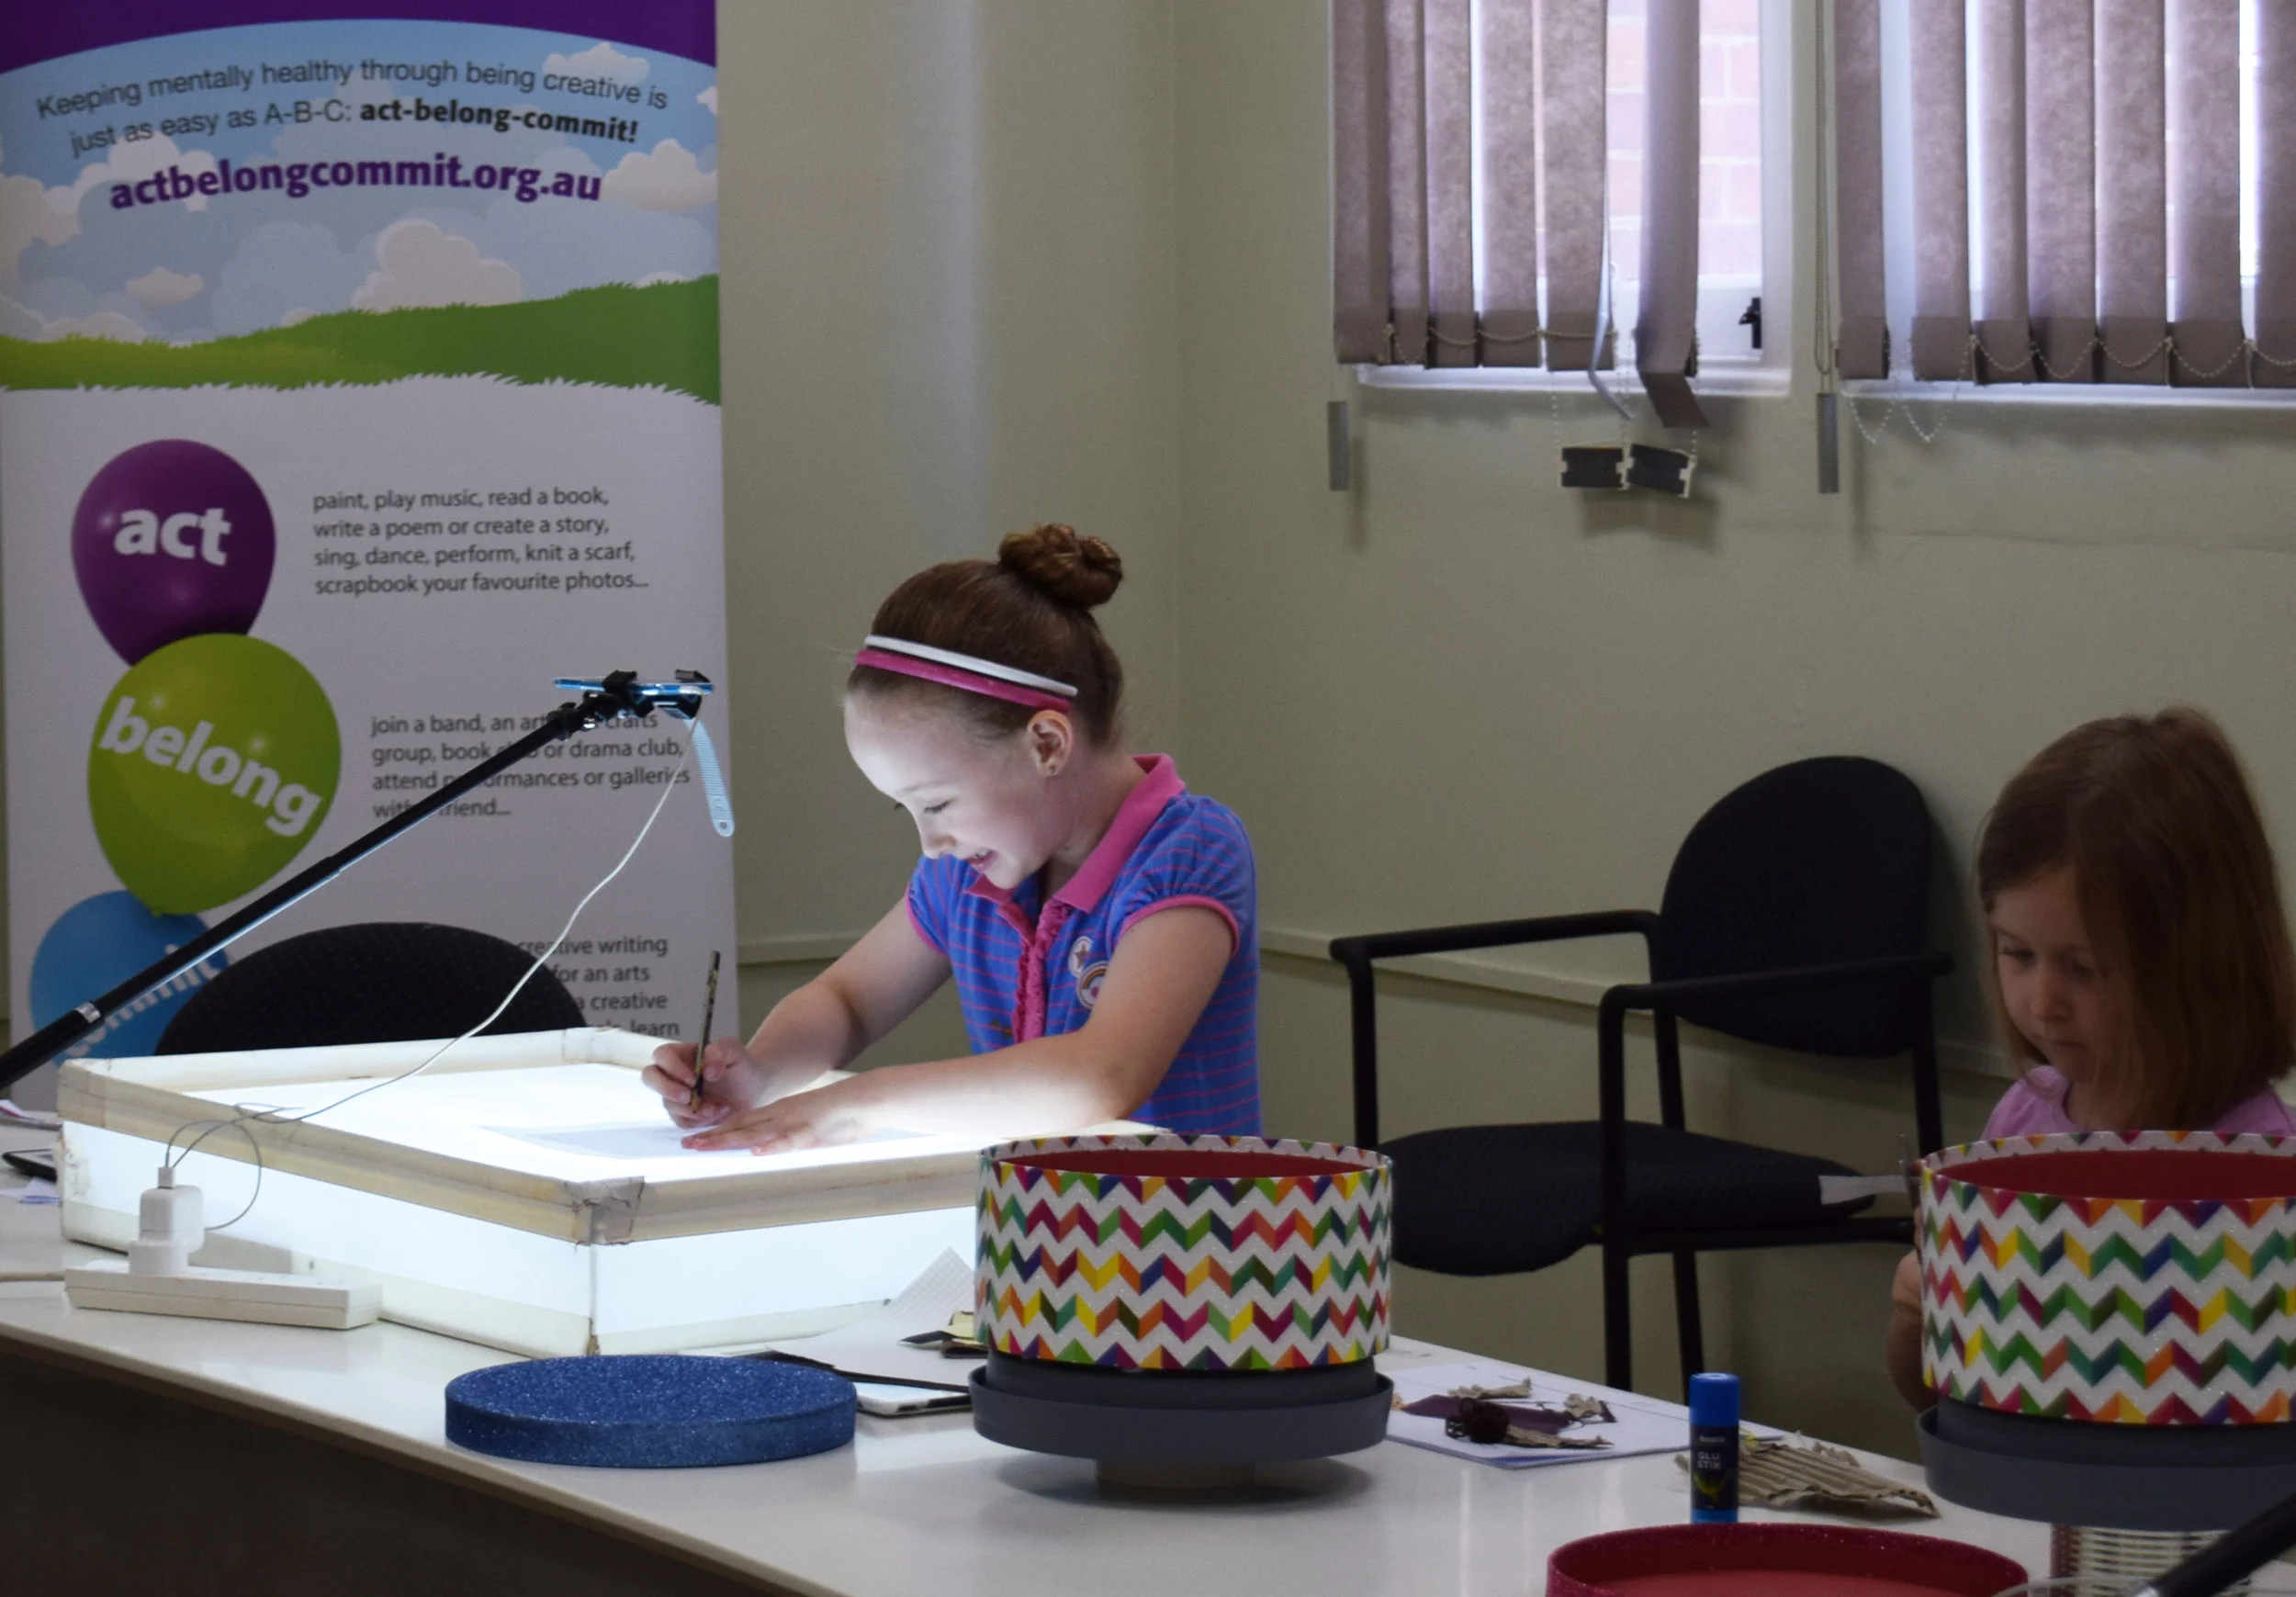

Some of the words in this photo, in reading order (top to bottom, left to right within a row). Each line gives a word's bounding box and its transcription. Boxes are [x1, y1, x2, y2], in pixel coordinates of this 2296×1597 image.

[36, 83, 141, 119] Keeping
[149, 65, 254, 97] mentally
[261, 60, 354, 85] healthy
[360, 59, 457, 86] through
[466, 62, 535, 93] being
[543, 73, 641, 104] creative
[647, 85, 669, 110] is
[70, 125, 117, 159] just
[124, 120, 154, 143] as
[160, 113, 219, 138] easy
[227, 108, 257, 129] as
[264, 99, 353, 125] A-B-C:
[360, 97, 639, 144] act-belong-commit!
[110, 152, 602, 210] actbelongcommit.org.au
[313, 490, 369, 513] paint,
[374, 489, 415, 512] play
[421, 489, 483, 508] music,
[488, 487, 532, 506] read
[536, 492, 548, 506] a
[553, 486, 610, 506] book,
[114, 507, 232, 567] act
[313, 520, 364, 537] write
[368, 523, 380, 536] a
[385, 521, 443, 540] poem
[447, 521, 469, 535] or
[474, 517, 535, 535] create
[539, 519, 551, 534] a
[556, 516, 610, 536] story,
[313, 548, 361, 569] sing,
[365, 546, 431, 566] dance,
[434, 544, 521, 567] perform,
[525, 544, 563, 562] knit
[568, 547, 580, 561] a
[583, 541, 636, 562] scarf,
[315, 575, 418, 598] scrapbook
[422, 576, 467, 595] your
[472, 572, 560, 591] favourite
[565, 570, 649, 593] photos...
[371, 716, 412, 737] join
[414, 719, 425, 733] a
[430, 715, 487, 734] band,
[490, 718, 516, 731] an
[372, 746, 437, 767] group,
[442, 742, 492, 760] book
[545, 744, 565, 759] or
[570, 738, 632, 758] drama
[638, 737, 684, 758] club,
[98, 695, 323, 838] belong
[372, 770, 437, 790] attend
[583, 770, 603, 785] or
[609, 766, 691, 790] galleries
[598, 936, 669, 957] writing
[583, 970, 609, 982] an
[613, 965, 650, 981] arts
[591, 992, 670, 1010] creative
